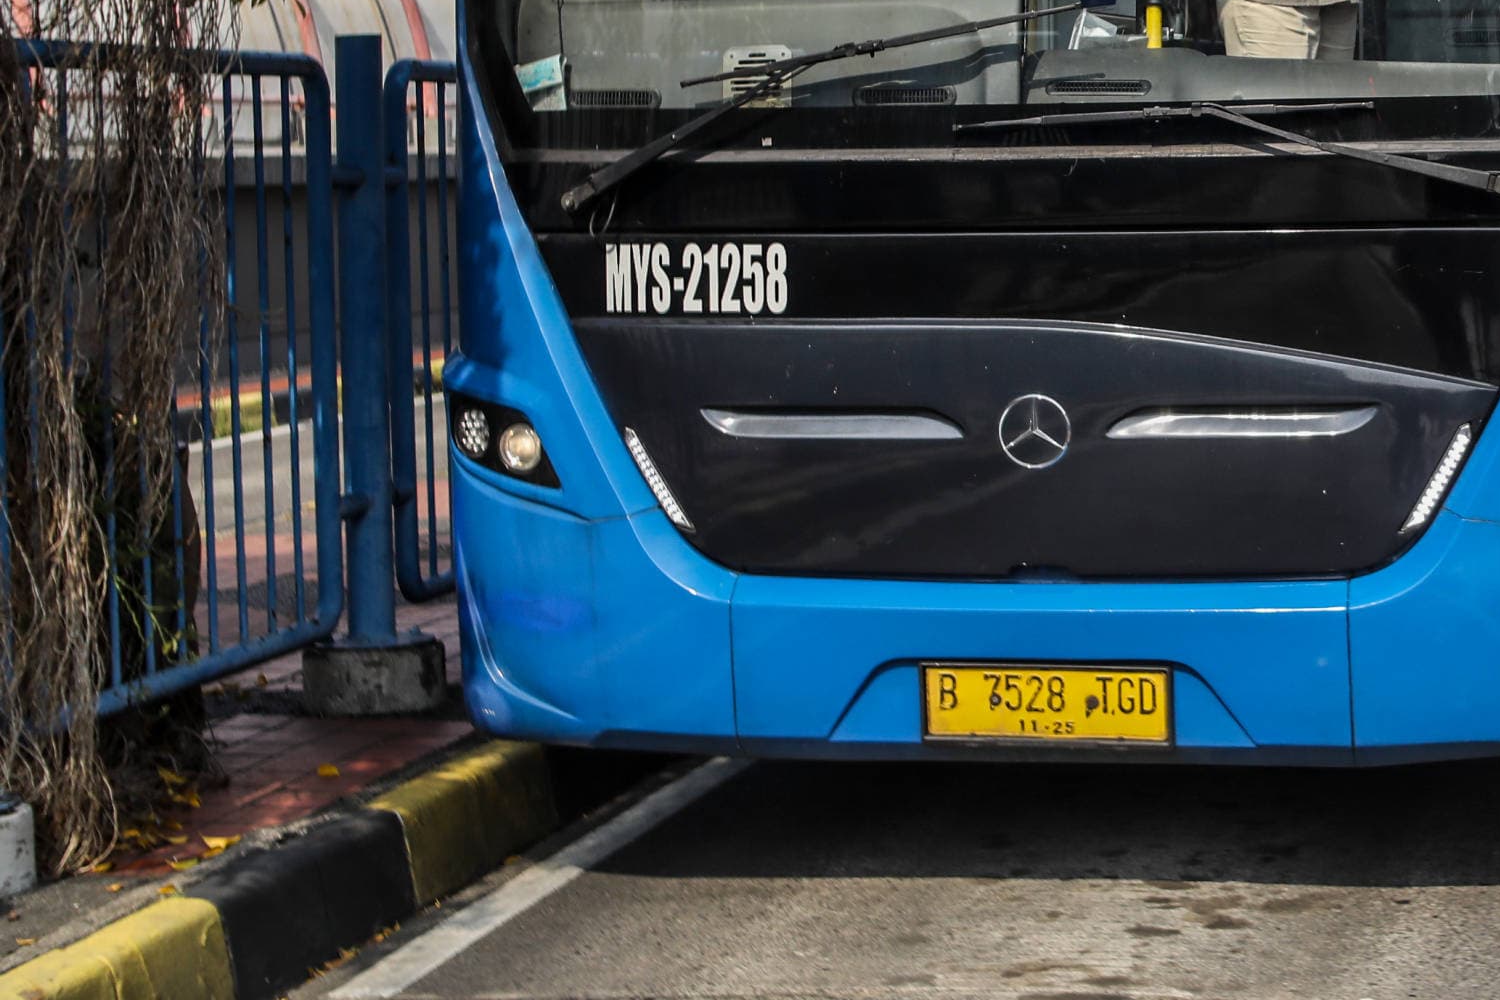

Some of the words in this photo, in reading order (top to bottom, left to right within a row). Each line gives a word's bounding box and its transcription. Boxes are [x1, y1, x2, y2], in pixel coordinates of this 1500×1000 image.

[605, 242, 788, 314] MYS-21258
[938, 673, 958, 710] B
[1095, 676, 1157, 715] TGD
